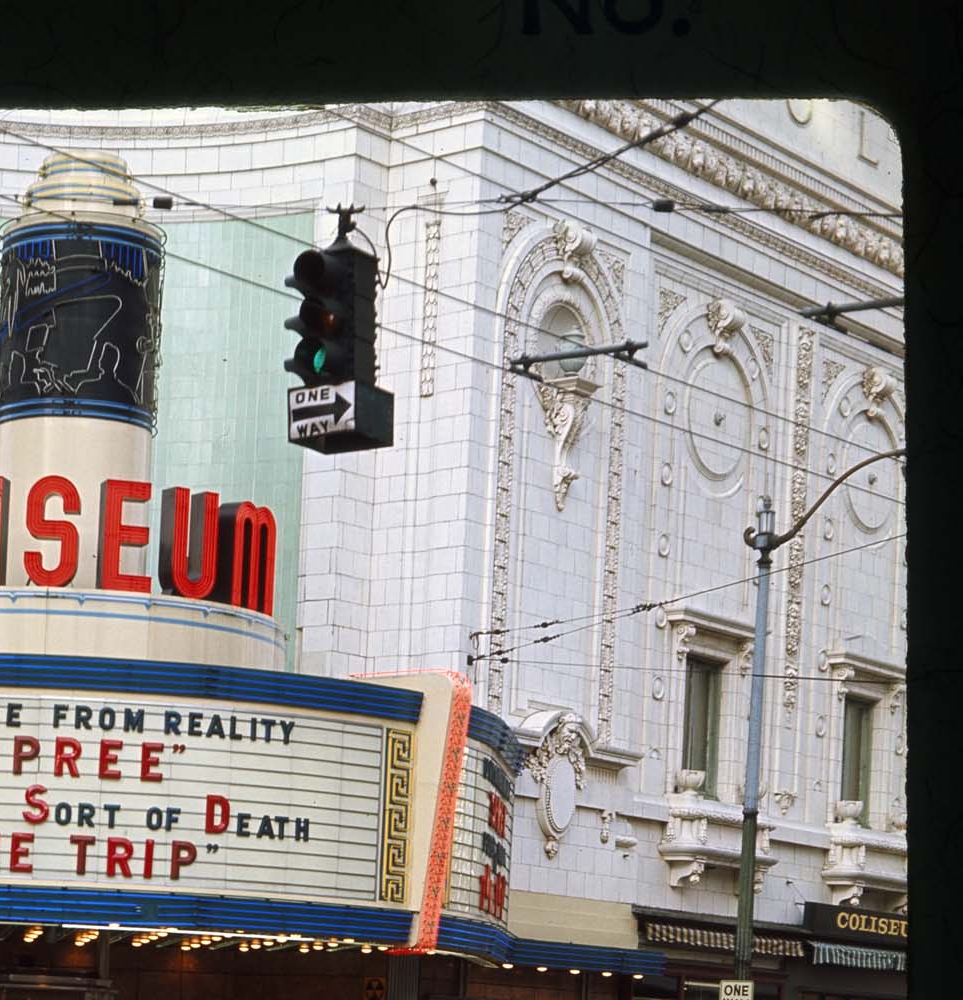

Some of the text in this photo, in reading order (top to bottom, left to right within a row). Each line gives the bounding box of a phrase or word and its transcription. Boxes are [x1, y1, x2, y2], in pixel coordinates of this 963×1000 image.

[295, 387, 330, 404] ONE
[297, 420, 329, 438] WAY
[52, 703, 145, 734] FROM
[164, 710, 296, 745] REALITY
[22, 784, 121, 829] SORT
[145, 806, 182, 832] OF
[204, 793, 310, 843] DEATH
[723, 984, 749, 997] ONE
